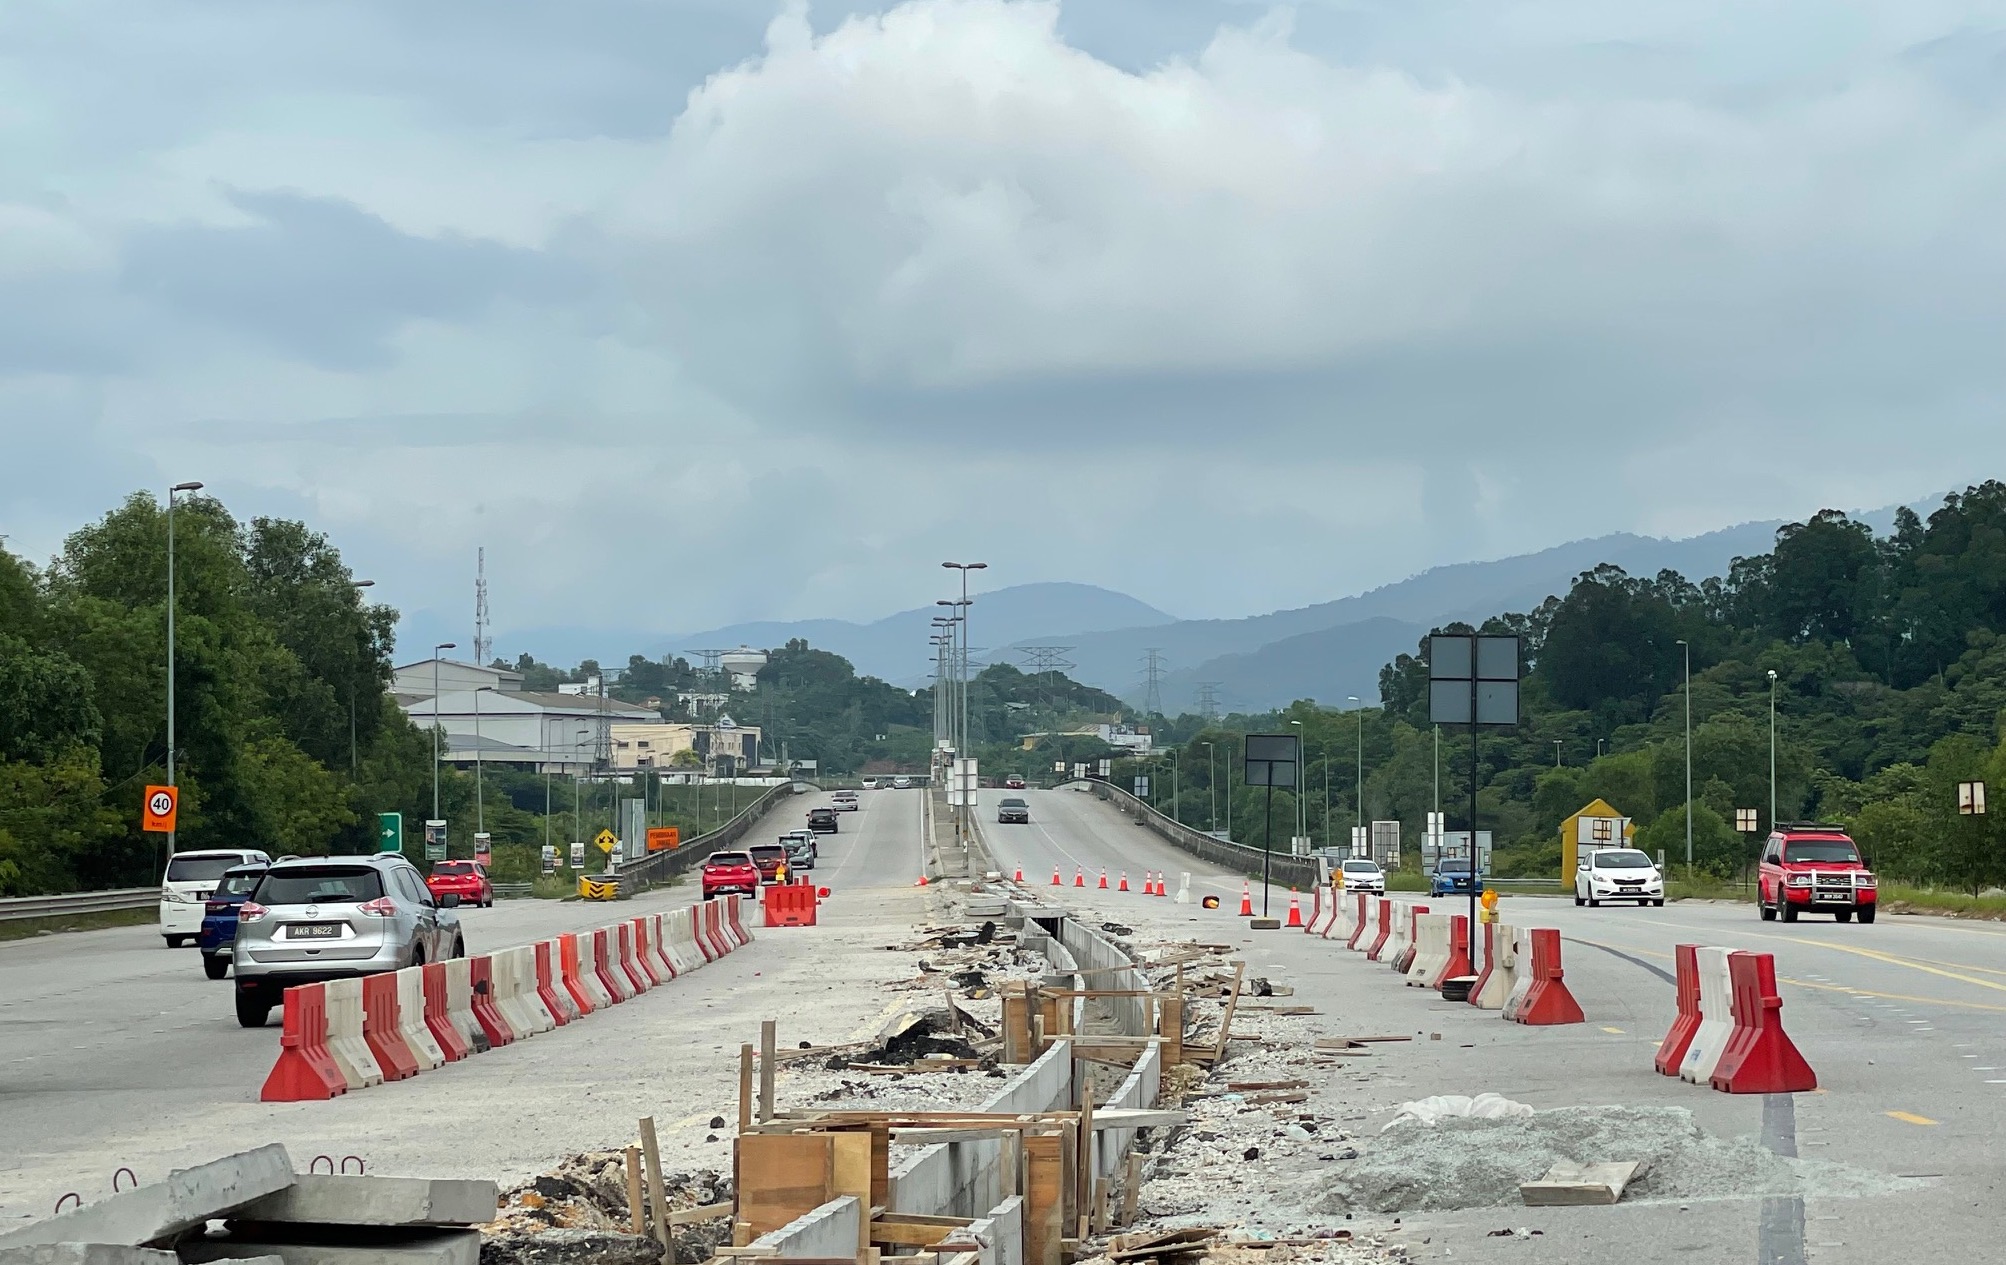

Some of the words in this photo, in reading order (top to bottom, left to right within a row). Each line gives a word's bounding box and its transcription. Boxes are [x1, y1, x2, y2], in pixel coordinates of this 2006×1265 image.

[153, 797, 169, 810] 40
[294, 927, 310, 936] AKR
[312, 926, 333, 936] 9622
